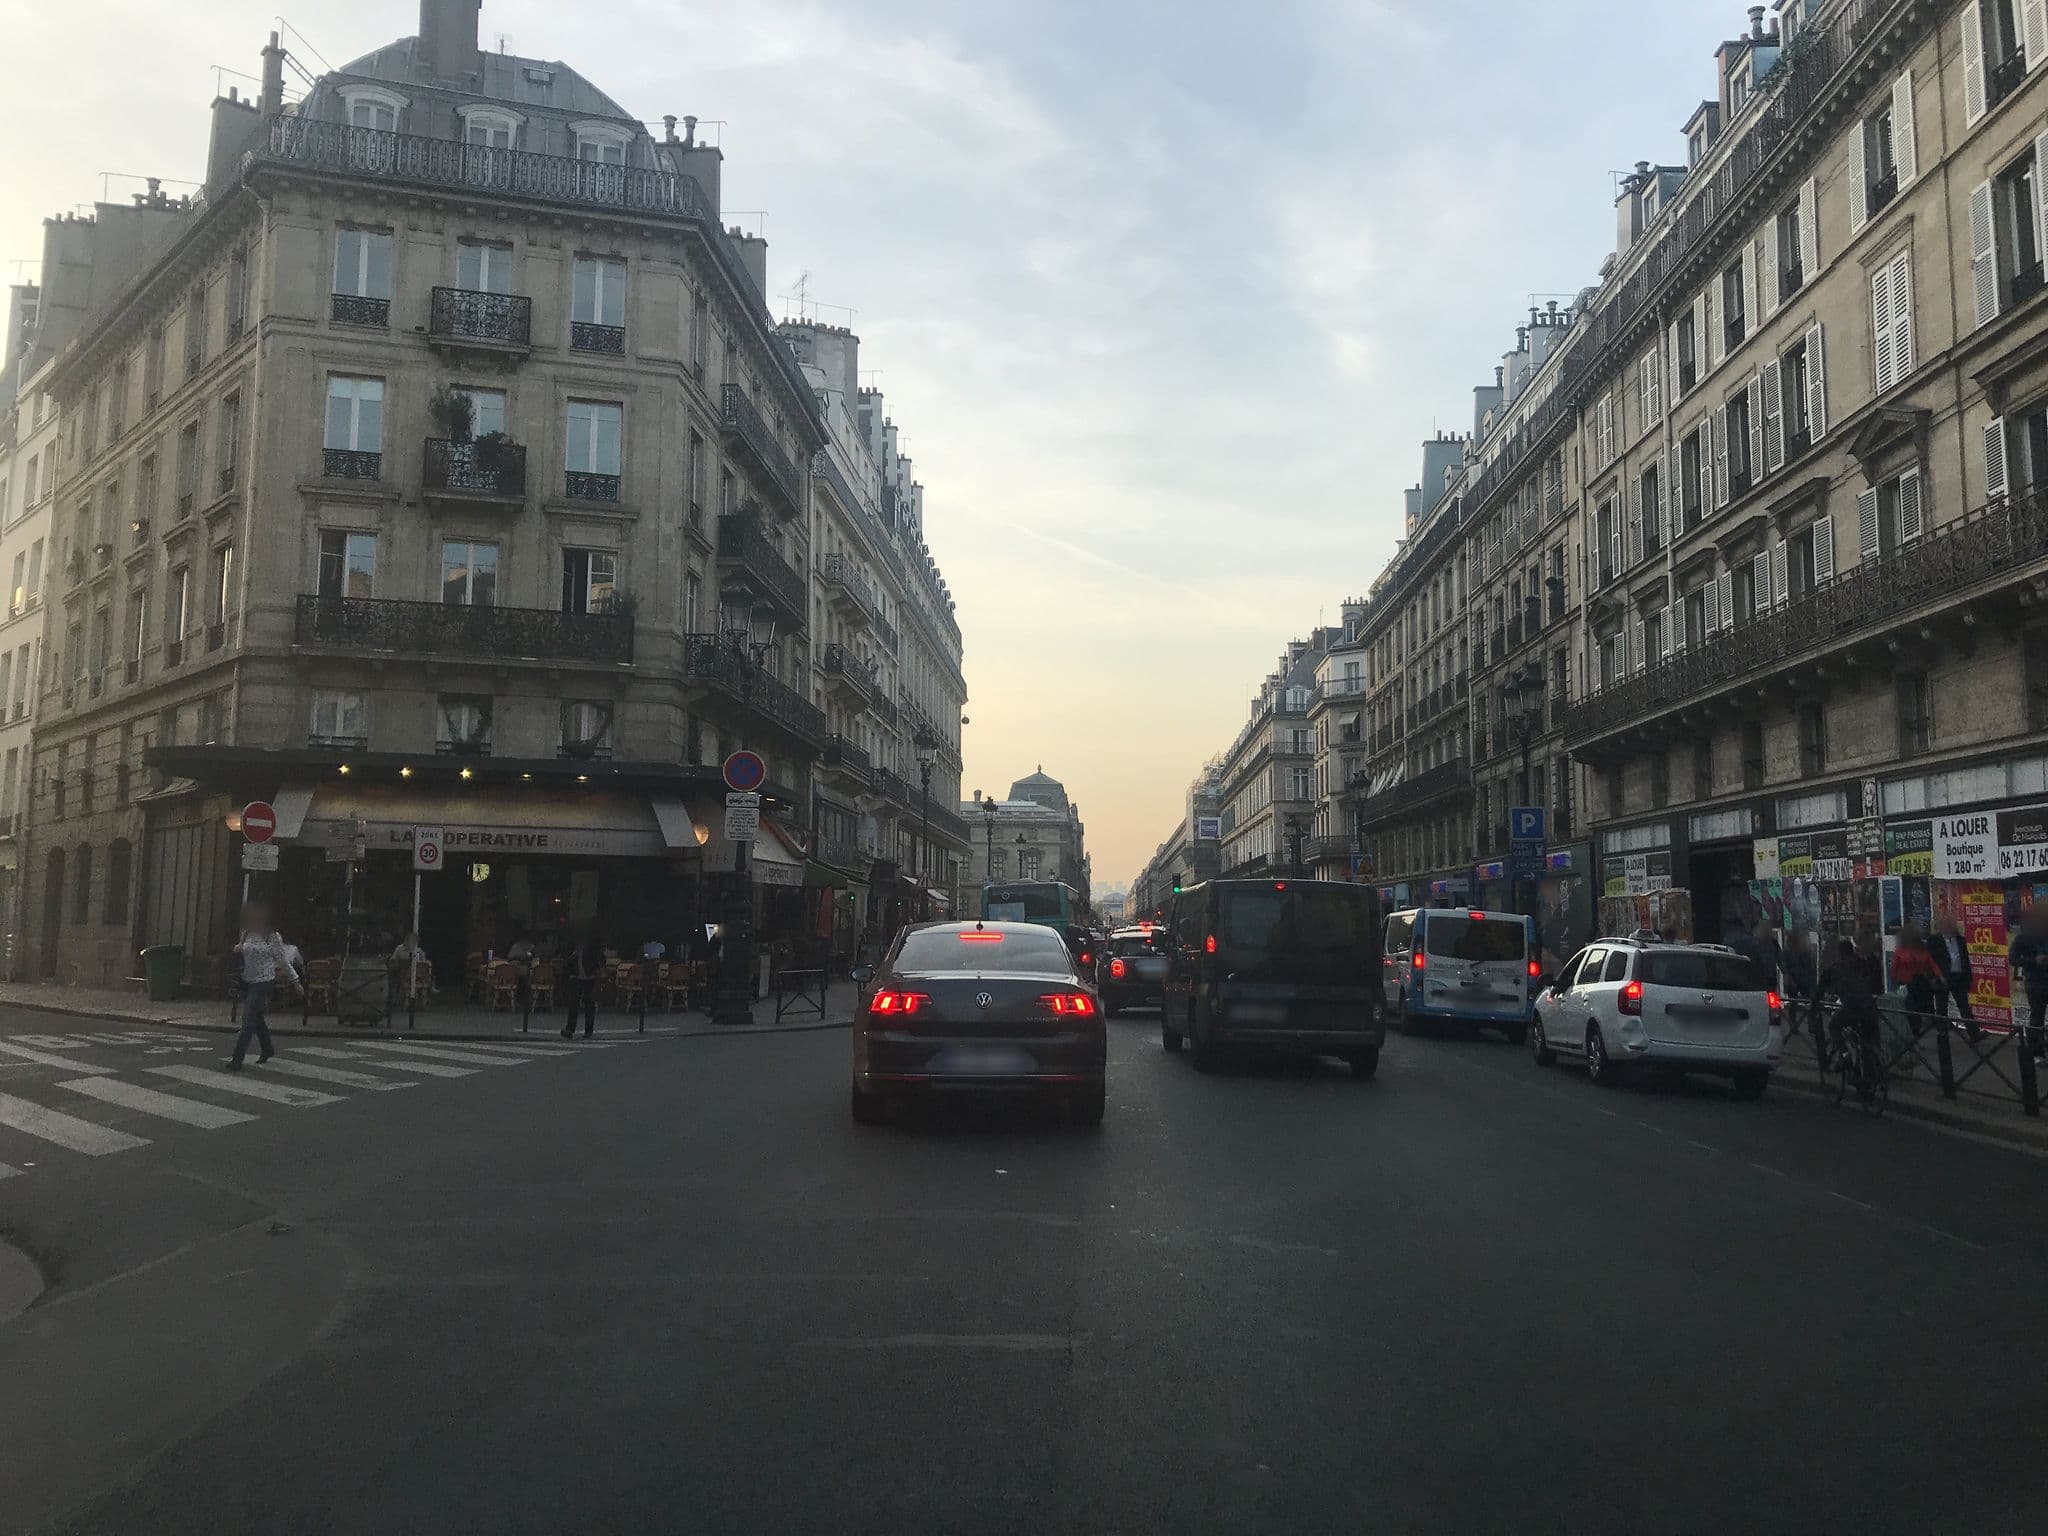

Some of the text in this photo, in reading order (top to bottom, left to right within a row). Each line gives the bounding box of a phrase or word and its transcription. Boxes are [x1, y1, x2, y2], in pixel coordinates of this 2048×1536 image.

[1521, 813, 1536, 834] P
[1940, 817, 1989, 839] A LOUER
[390, 830, 414, 843] LA
[444, 831, 549, 847] OPERATIVE
[423, 848, 435, 858] 30
[1946, 841, 1983, 858] Boutique
[1954, 860, 1971, 874] 280
[2000, 851, 2011, 869] 06
[2013, 850, 2024, 868] 22
[2027, 849, 2036, 867] 17
